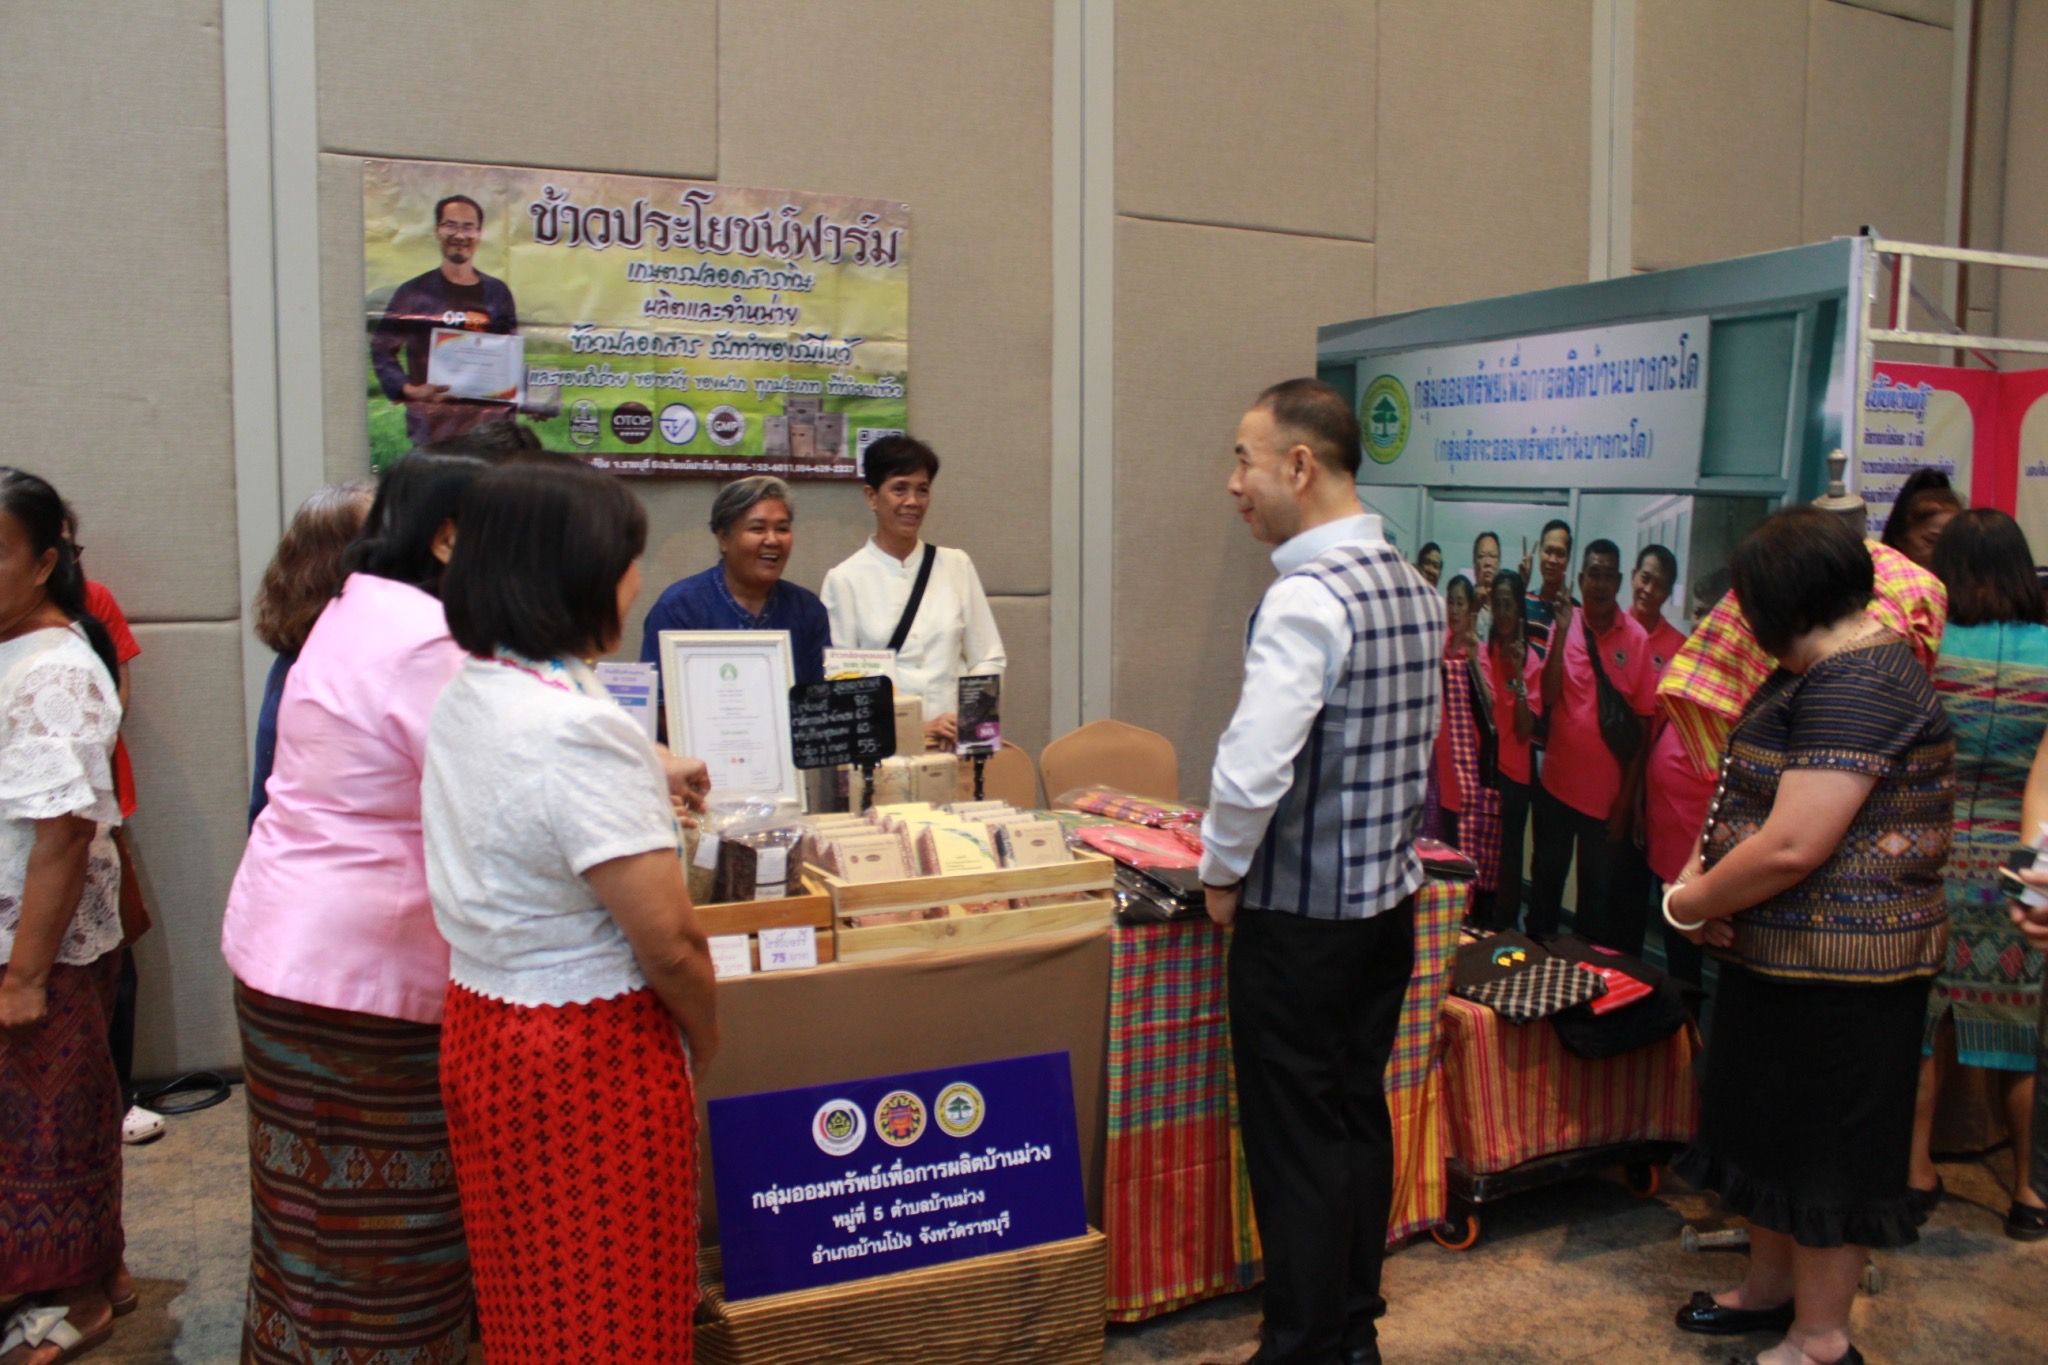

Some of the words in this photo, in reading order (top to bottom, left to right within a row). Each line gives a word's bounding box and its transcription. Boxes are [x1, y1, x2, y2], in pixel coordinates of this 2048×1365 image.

[531, 187, 900, 265] ข้าวประโยชน์ฟาร์ม
[628, 261, 814, 291] เกษตรปลอดสารพิษ
[644, 289, 799, 324] ผลิตและจำหน่าย
[570, 323, 703, 356] ข้าวปลอดสาร
[613, 415, 650, 426] OTOP
[714, 420, 739, 432] GMP
[771, 952, 786, 964] 75
[751, 1141, 1051, 1215] กลุ่มออมทรัพย์เพื่อการผลิตบ้านม่วง
[832, 1202, 867, 1235] หมู่ที่
[873, 1206, 884, 1222] 5
[890, 1188, 985, 1218] ตำบลบ้านม่วง
[811, 1229, 912, 1265] อำเภอบ้านโป่ง
[919, 1210, 1010, 1246] จังหวัดราชบุรี
